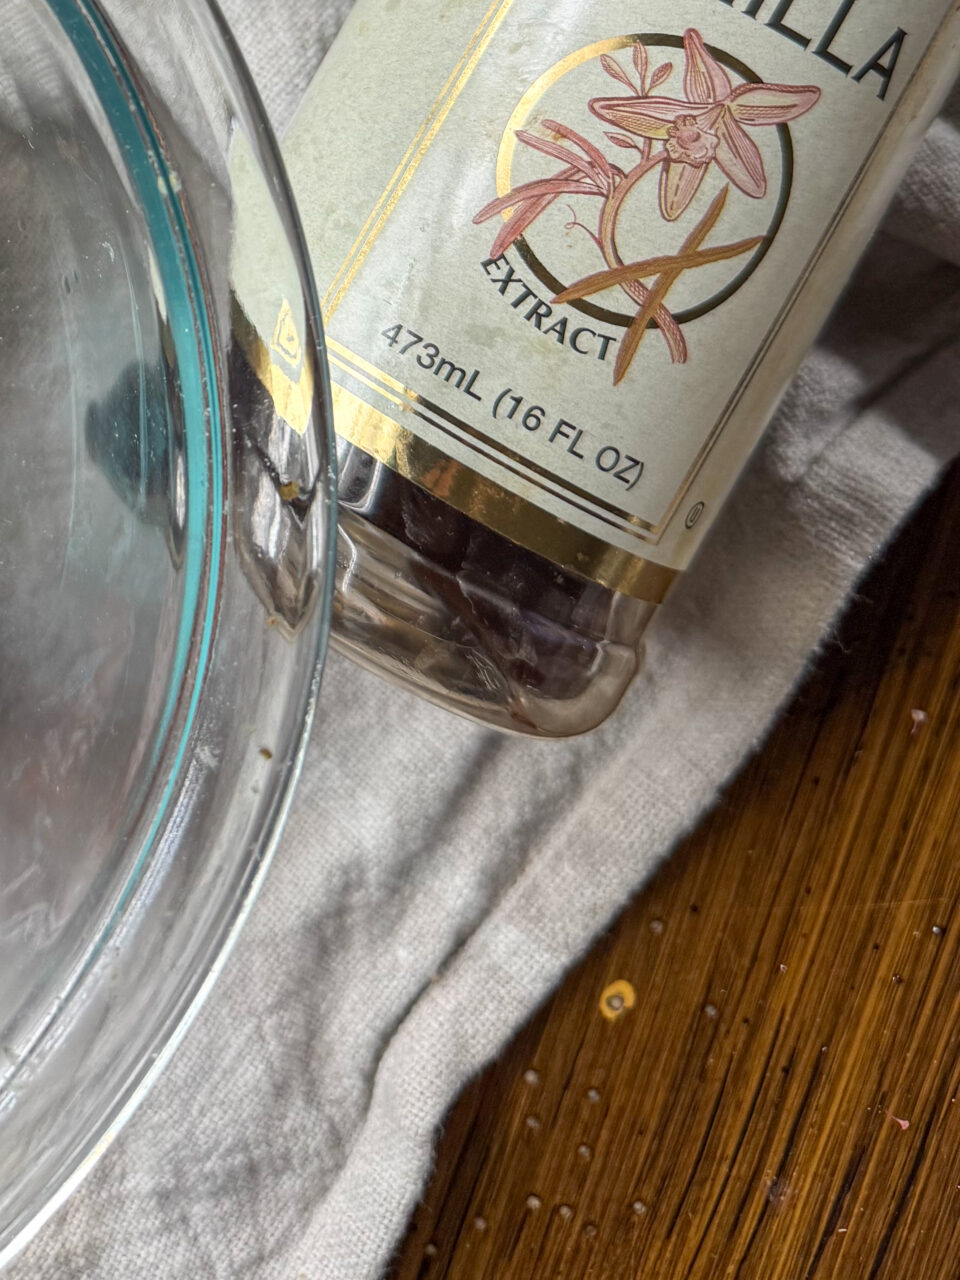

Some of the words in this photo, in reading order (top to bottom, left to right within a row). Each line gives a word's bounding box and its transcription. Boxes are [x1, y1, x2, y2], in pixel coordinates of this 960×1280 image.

[480, 254, 617, 361] EXTRACT
[380, 323, 483, 402] 473mL
[491, 388, 546, 432] (16
[548, 419, 585, 460] FL
[595, 445, 645, 492] OZ)
